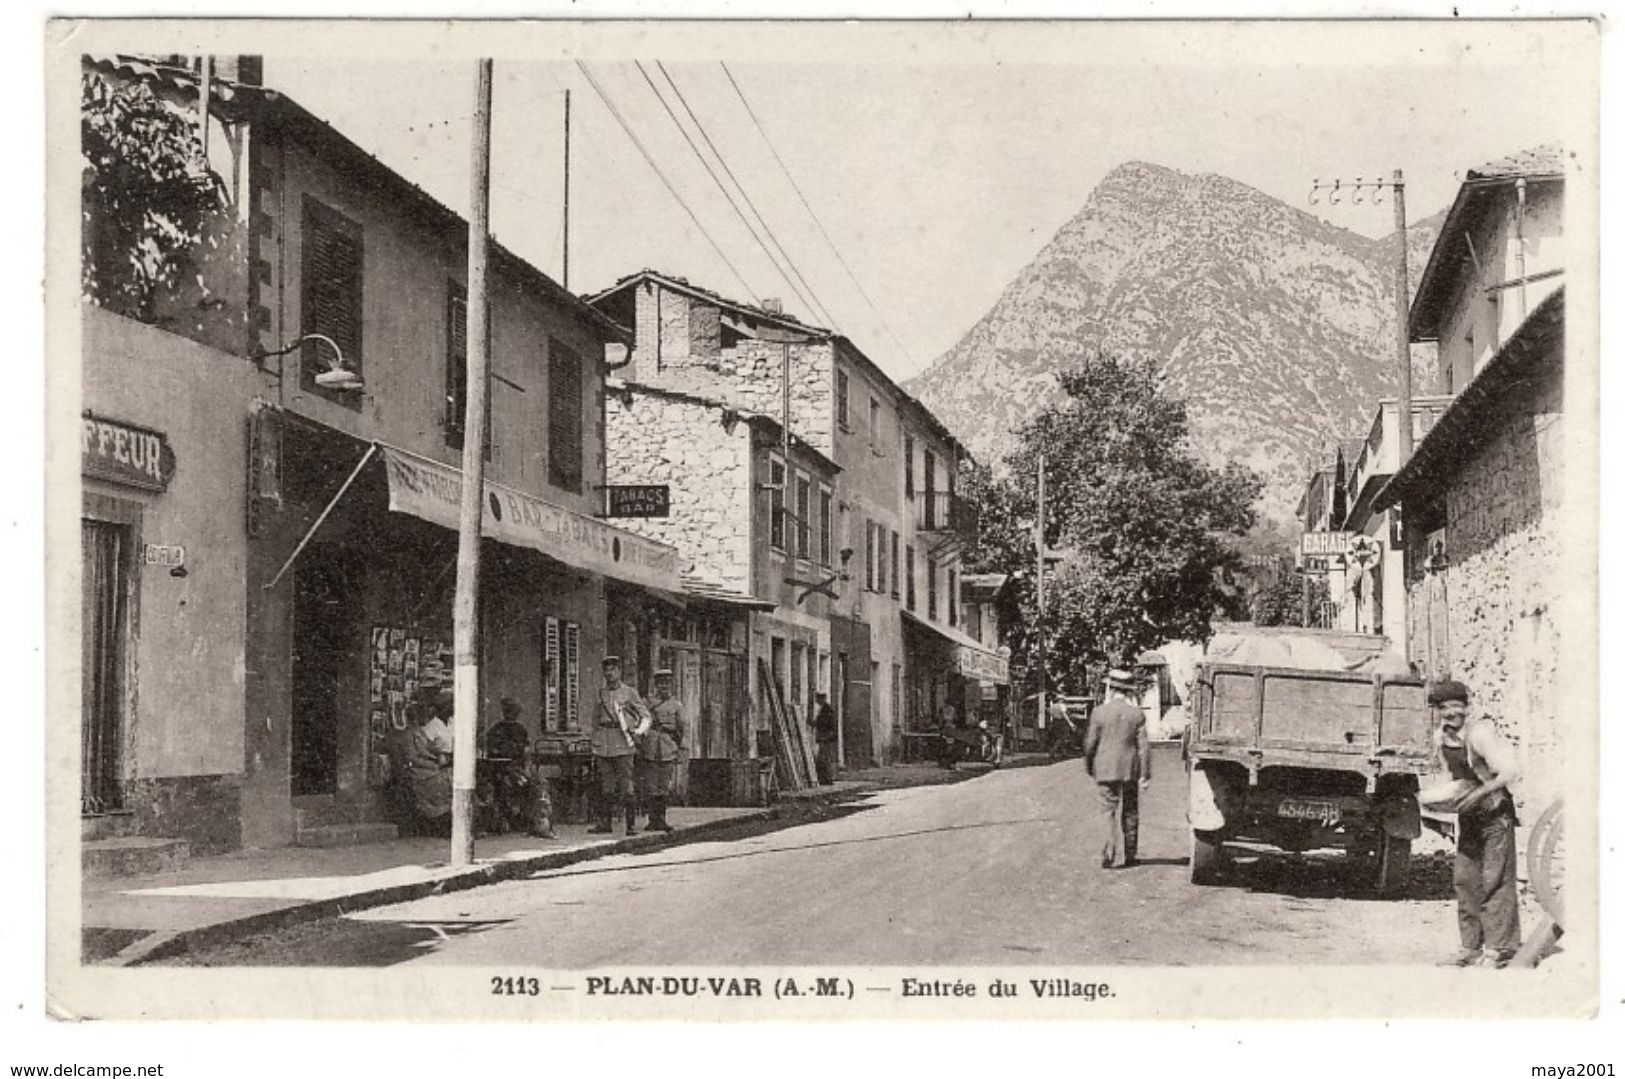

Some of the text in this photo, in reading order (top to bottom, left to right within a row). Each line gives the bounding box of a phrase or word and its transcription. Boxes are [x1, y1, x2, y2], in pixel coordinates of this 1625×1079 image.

[82, 419, 162, 482] FFEUR
[612, 488, 665, 505] TABACS
[620, 503, 656, 513] BAR
